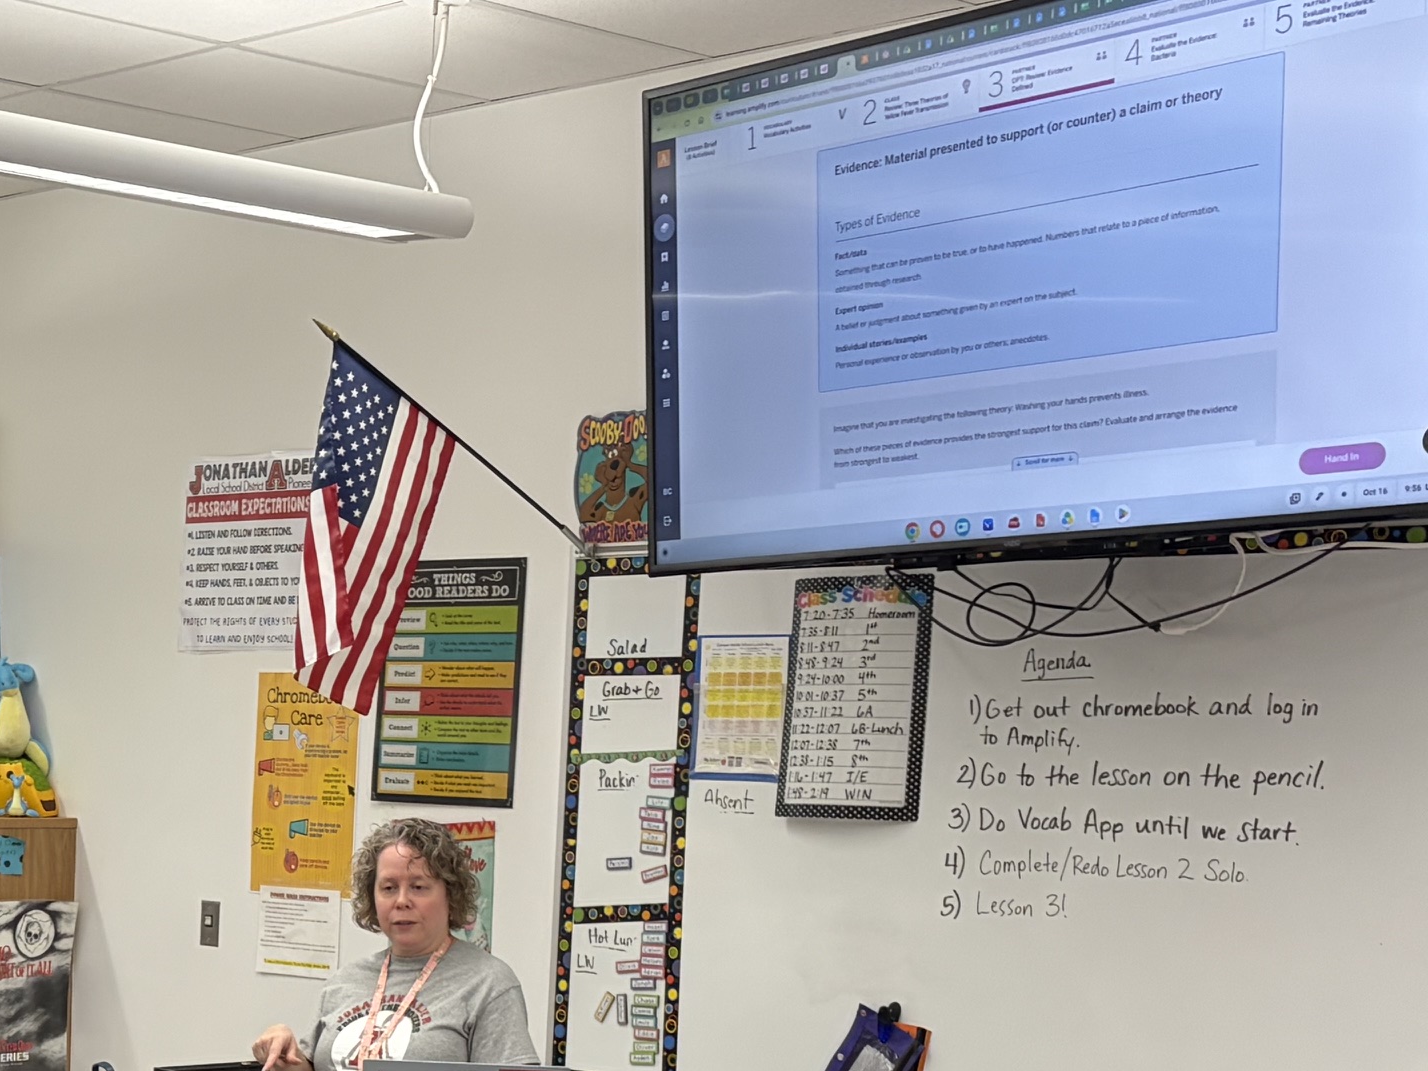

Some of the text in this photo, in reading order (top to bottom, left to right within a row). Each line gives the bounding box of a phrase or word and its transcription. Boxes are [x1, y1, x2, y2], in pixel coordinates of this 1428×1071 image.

[1275, 4, 1293, 34] 5
[1125, 39, 1142, 65] 4
[988, 70, 1005, 98] 3
[862, 99, 877, 126] 2
[748, 127, 757, 150] 1
[834, 87, 1223, 176] Evidence: Material presented to support (or counter) a claim or theory
[835, 208, 921, 234] Types of Evidence
[913, 434, 942, 447] evidence
[943, 431, 973, 445] provides
[974, 430, 986, 440] the
[987, 425, 1020, 440] strongest
[1022, 422, 1050, 437] support
[1051, 421, 1062, 431] for
[1063, 418, 1078, 430] this
[1079, 414, 1104, 429] claim?
[1105, 412, 1138, 426] Evaluate
[1139, 410, 1154, 421] and
[1155, 407, 1186, 422] arrange
[1187, 405, 1200, 416] the
[1202, 403, 1238, 415] evidence
[1324, 451, 1360, 464] Hand In
[189, 461, 268, 495] JONATHAN
[222, 481, 242, 493] School
[187, 495, 310, 518] CLASSROOM EXPECTATIONS
[195, 530, 215, 539] LISTEN
[217, 529, 229, 538] AND
[230, 528, 252, 538] FOLLOW
[614, 521, 631, 541] ARE
[433, 573, 476, 585] THINGS
[408, 585, 509, 598] OOD READERS DO
[798, 590, 837, 608] Class
[868, 607, 915, 619] Homeroom
[607, 639, 647, 656] Salad
[862, 637, 880, 651] 2nd
[859, 654, 876, 668] 3rd
[1023, 648, 1091, 679] Agenda
[858, 672, 876, 684] 4th
[645, 683, 660, 697] Go
[858, 688, 877, 701] 5th
[1033, 696, 1071, 718] out
[1082, 691, 1200, 718] chromebook
[1209, 693, 1252, 716] and
[1267, 692, 1293, 724] log
[1301, 699, 1318, 716] in
[291, 710, 323, 726] Care
[853, 739, 870, 750] 7th
[980, 725, 1080, 756] to Amplify.
[599, 769, 638, 788] Packin
[1016, 762, 1035, 786] to
[1045, 765, 1079, 786] the
[1092, 760, 1151, 786] lesson
[1163, 771, 1190, 786] on
[1200, 763, 1241, 789] the
[1253, 760, 1324, 796] pencil.
[845, 789, 872, 800] WIN
[980, 807, 1006, 832] Do
[1018, 806, 1072, 831] Vocab
[1084, 808, 1124, 842] App
[1136, 815, 1189, 840] until
[1202, 825, 1226, 841] we
[944, 846, 965, 879] 4)
[1116, 854, 1167, 879] Lesson
[1177, 858, 1195, 880] 2
[940, 889, 1067, 920] 5) Lesson 3!
[588, 928, 608, 944] Hot
